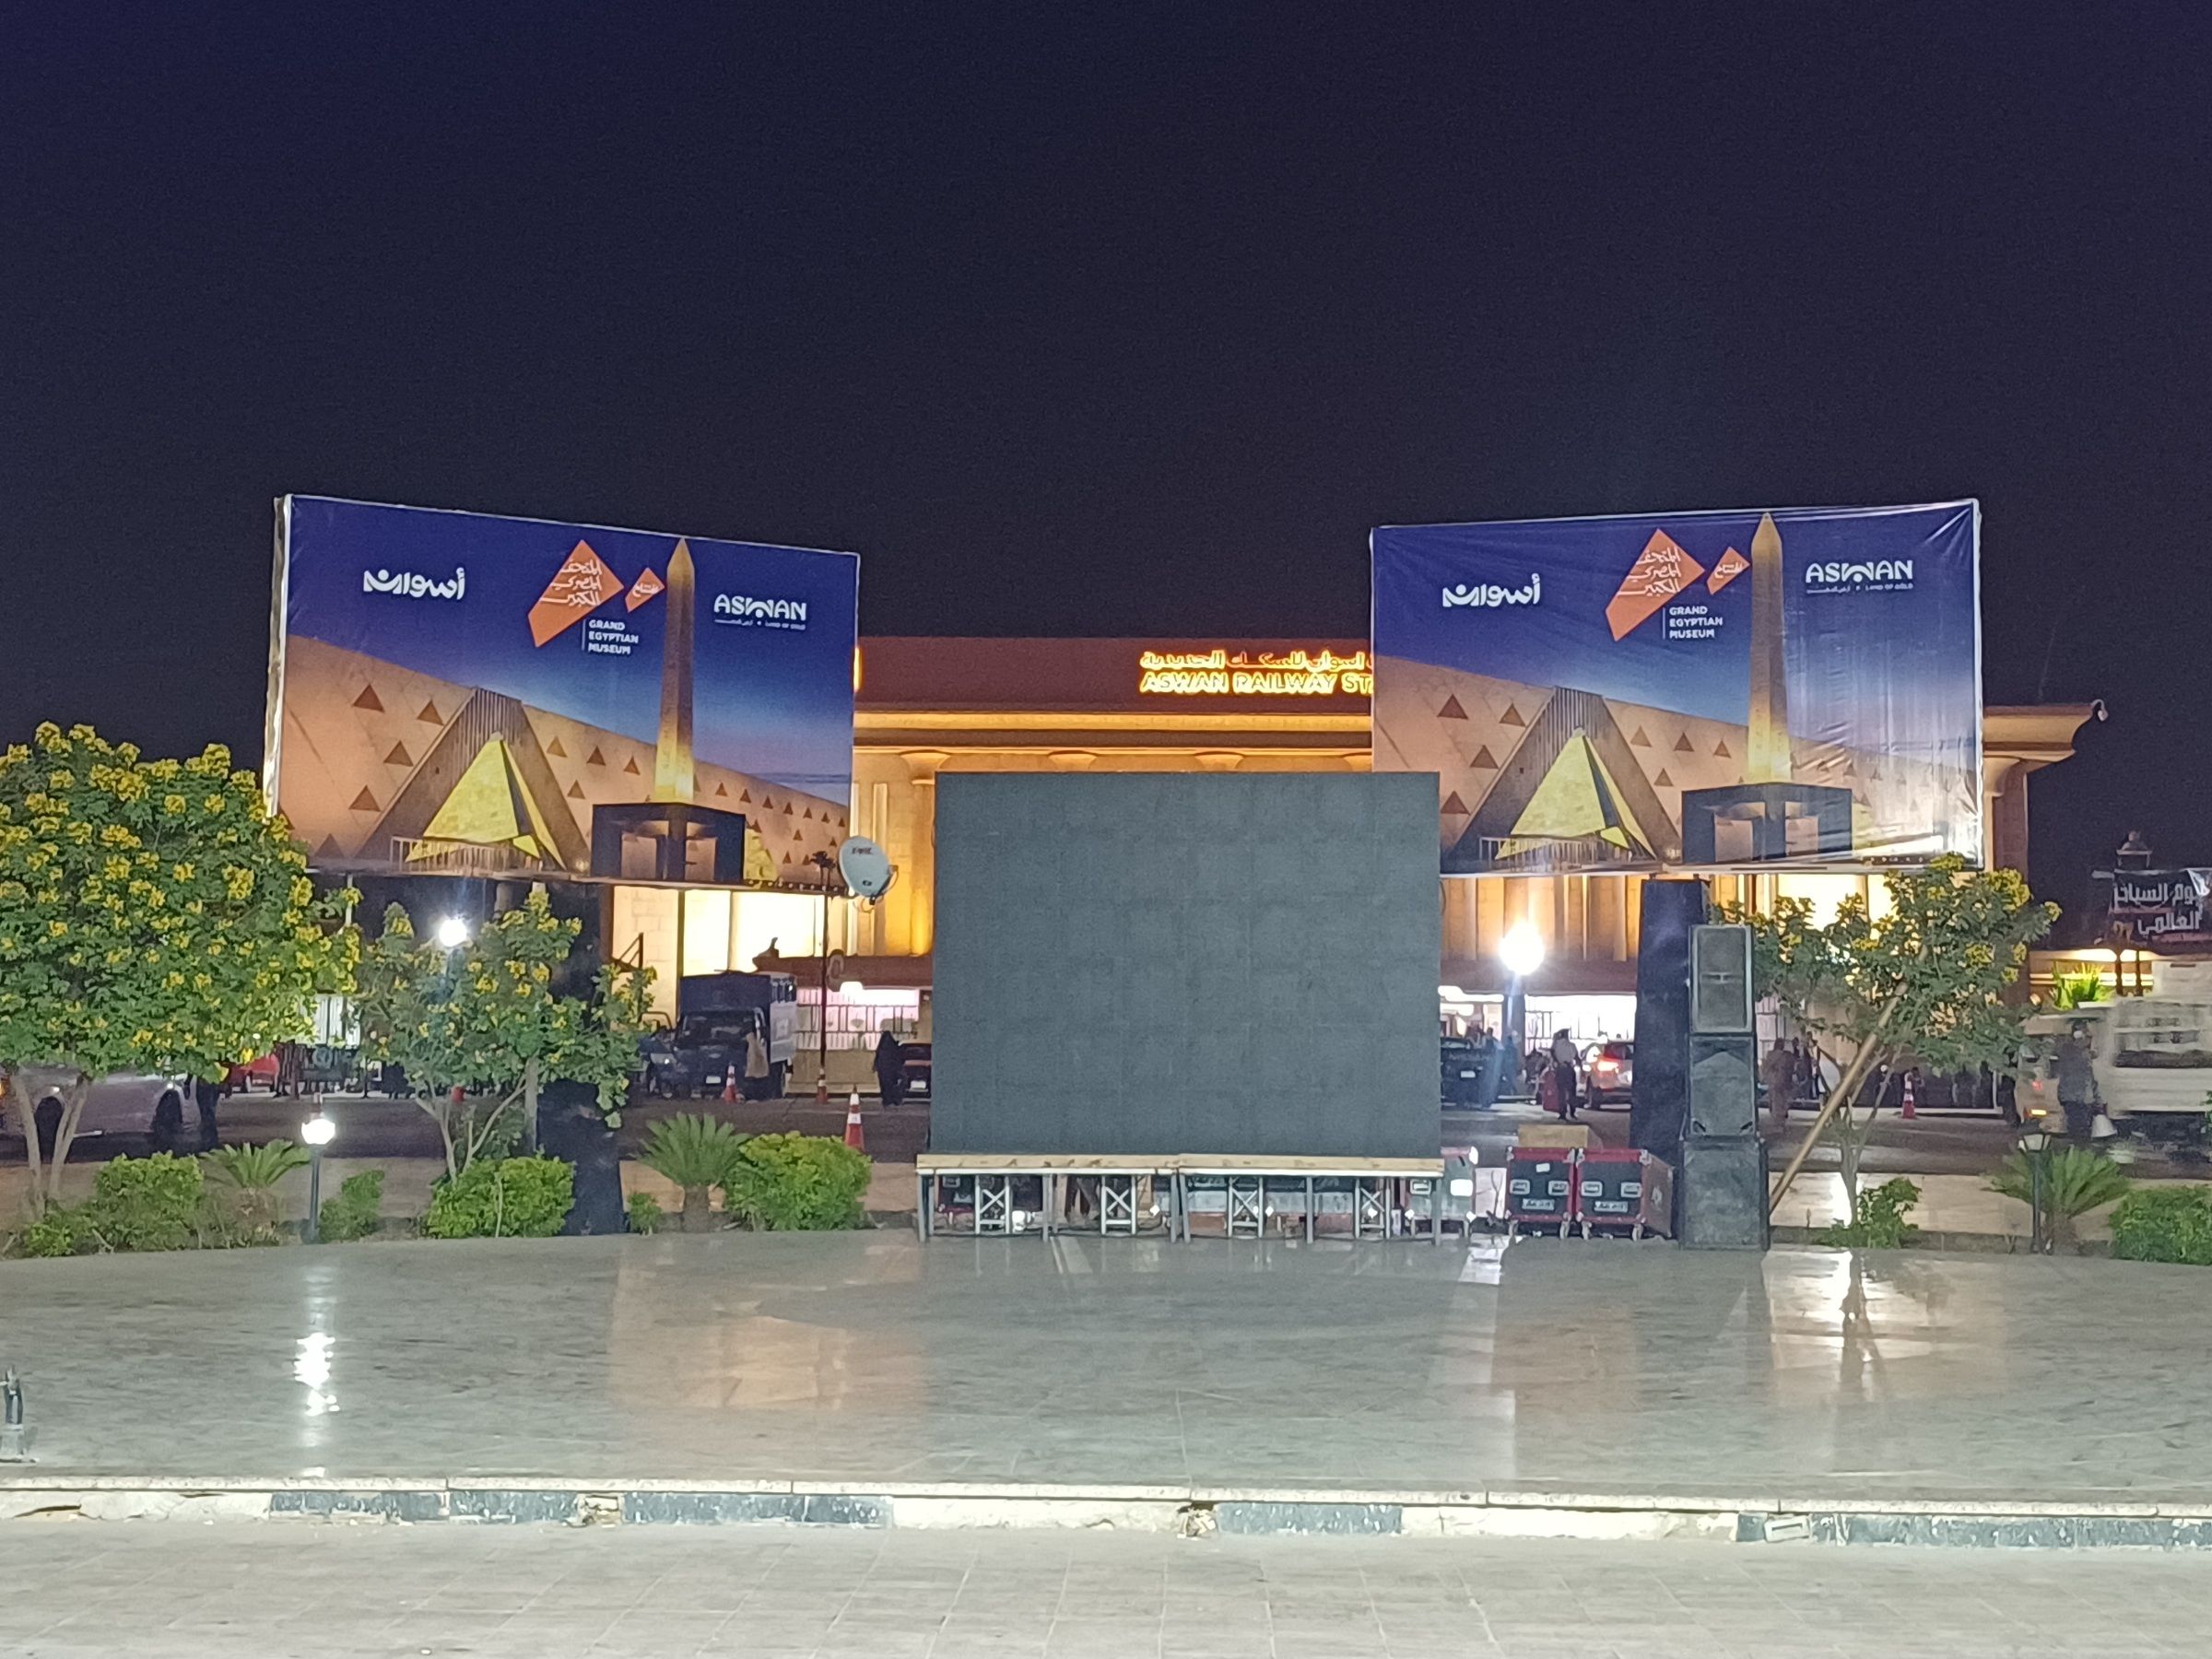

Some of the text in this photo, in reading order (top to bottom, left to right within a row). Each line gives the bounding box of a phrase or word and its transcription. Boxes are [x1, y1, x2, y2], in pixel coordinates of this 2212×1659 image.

[1806, 559, 1913, 583] ASWAN
[363, 567, 465, 600] أسوان
[1442, 572, 1540, 606] أسوان
[713, 594, 807, 621] ASWAN
[1669, 606, 1708, 616] GRAND
[588, 619, 626, 630] GRAND
[1669, 617, 1724, 628] EGYPTIAN
[588, 631, 640, 643] EGYPTIAN
[1669, 629, 1715, 639] MUSEUM
[588, 643, 631, 654] MUSEUM
[1139, 671, 1229, 694] ASWAN
[1232, 671, 1338, 695] RAILWAY
